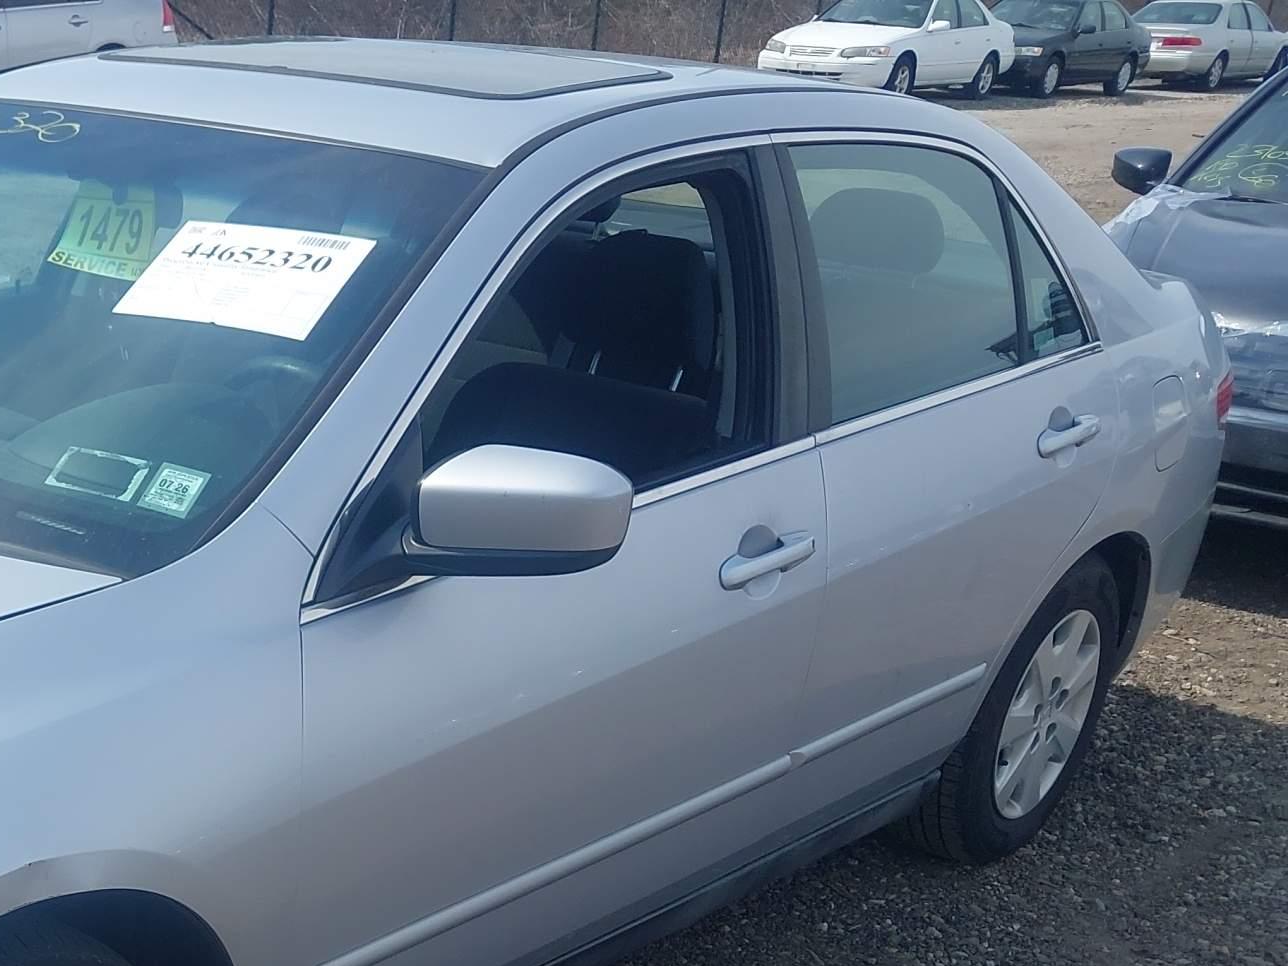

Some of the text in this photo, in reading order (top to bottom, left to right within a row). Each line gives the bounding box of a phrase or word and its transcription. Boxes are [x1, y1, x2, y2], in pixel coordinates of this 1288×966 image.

[77, 205, 144, 255] 1479
[51, 251, 128, 276] SERVICE
[181, 241, 333, 273] 44652320
